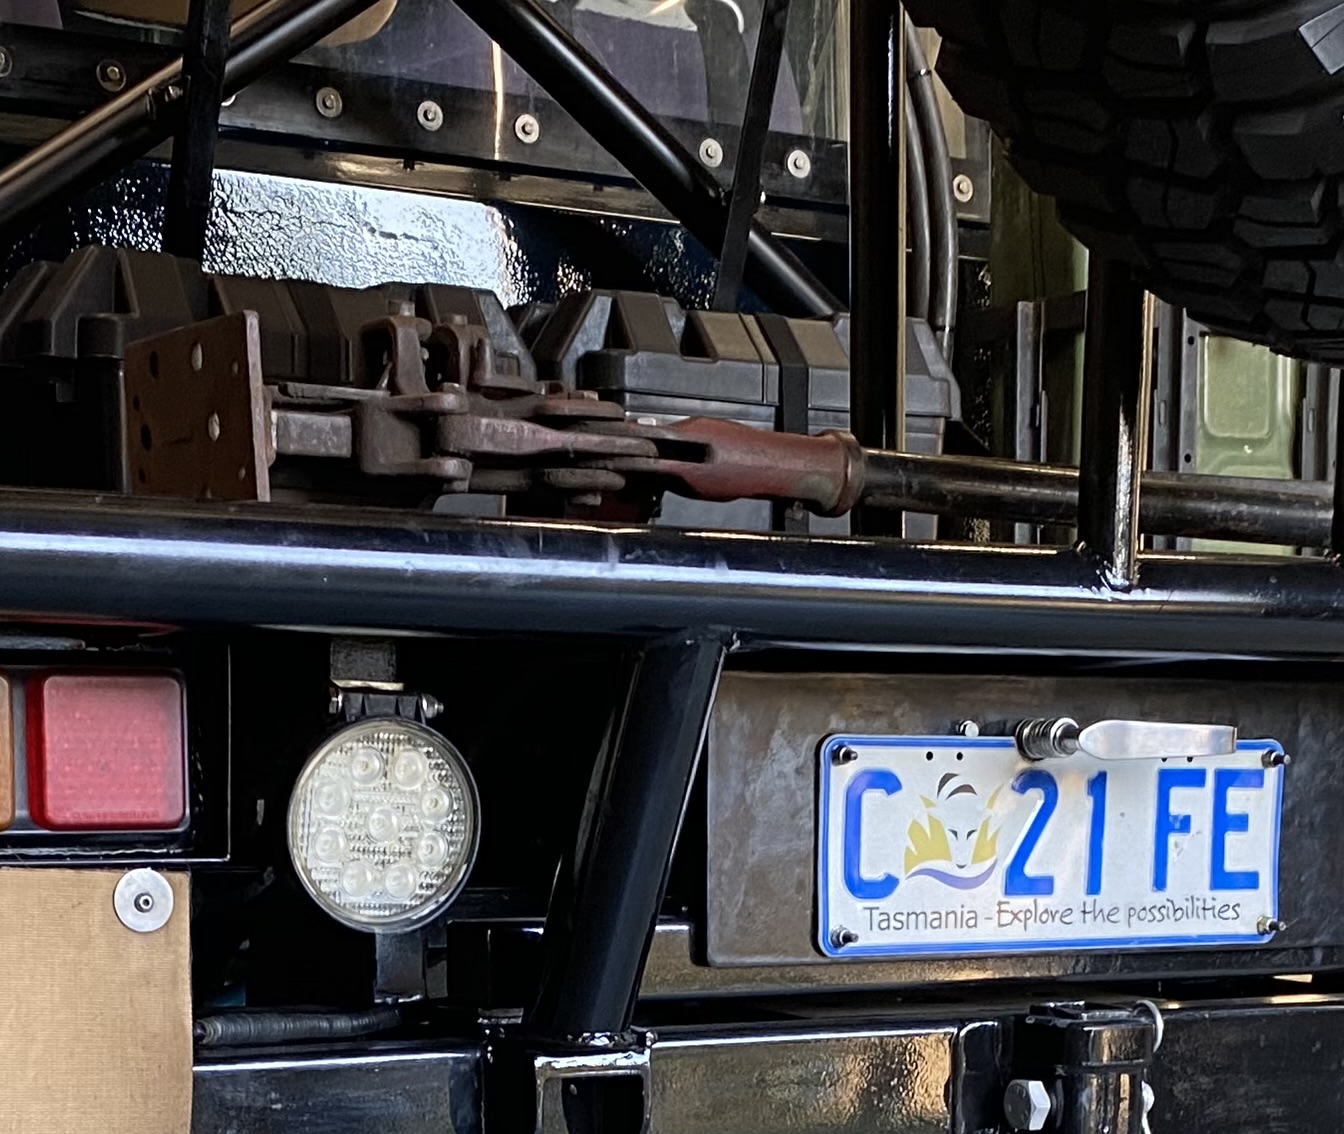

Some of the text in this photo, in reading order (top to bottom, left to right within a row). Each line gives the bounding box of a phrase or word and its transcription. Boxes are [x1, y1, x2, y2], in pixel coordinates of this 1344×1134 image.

[843, 768, 1266, 900] C 21 FE
[863, 904, 978, 932] Tasmania
[996, 898, 1074, 932] Explore
[1080, 898, 1120, 925] the
[1127, 895, 1242, 929] possibilities
